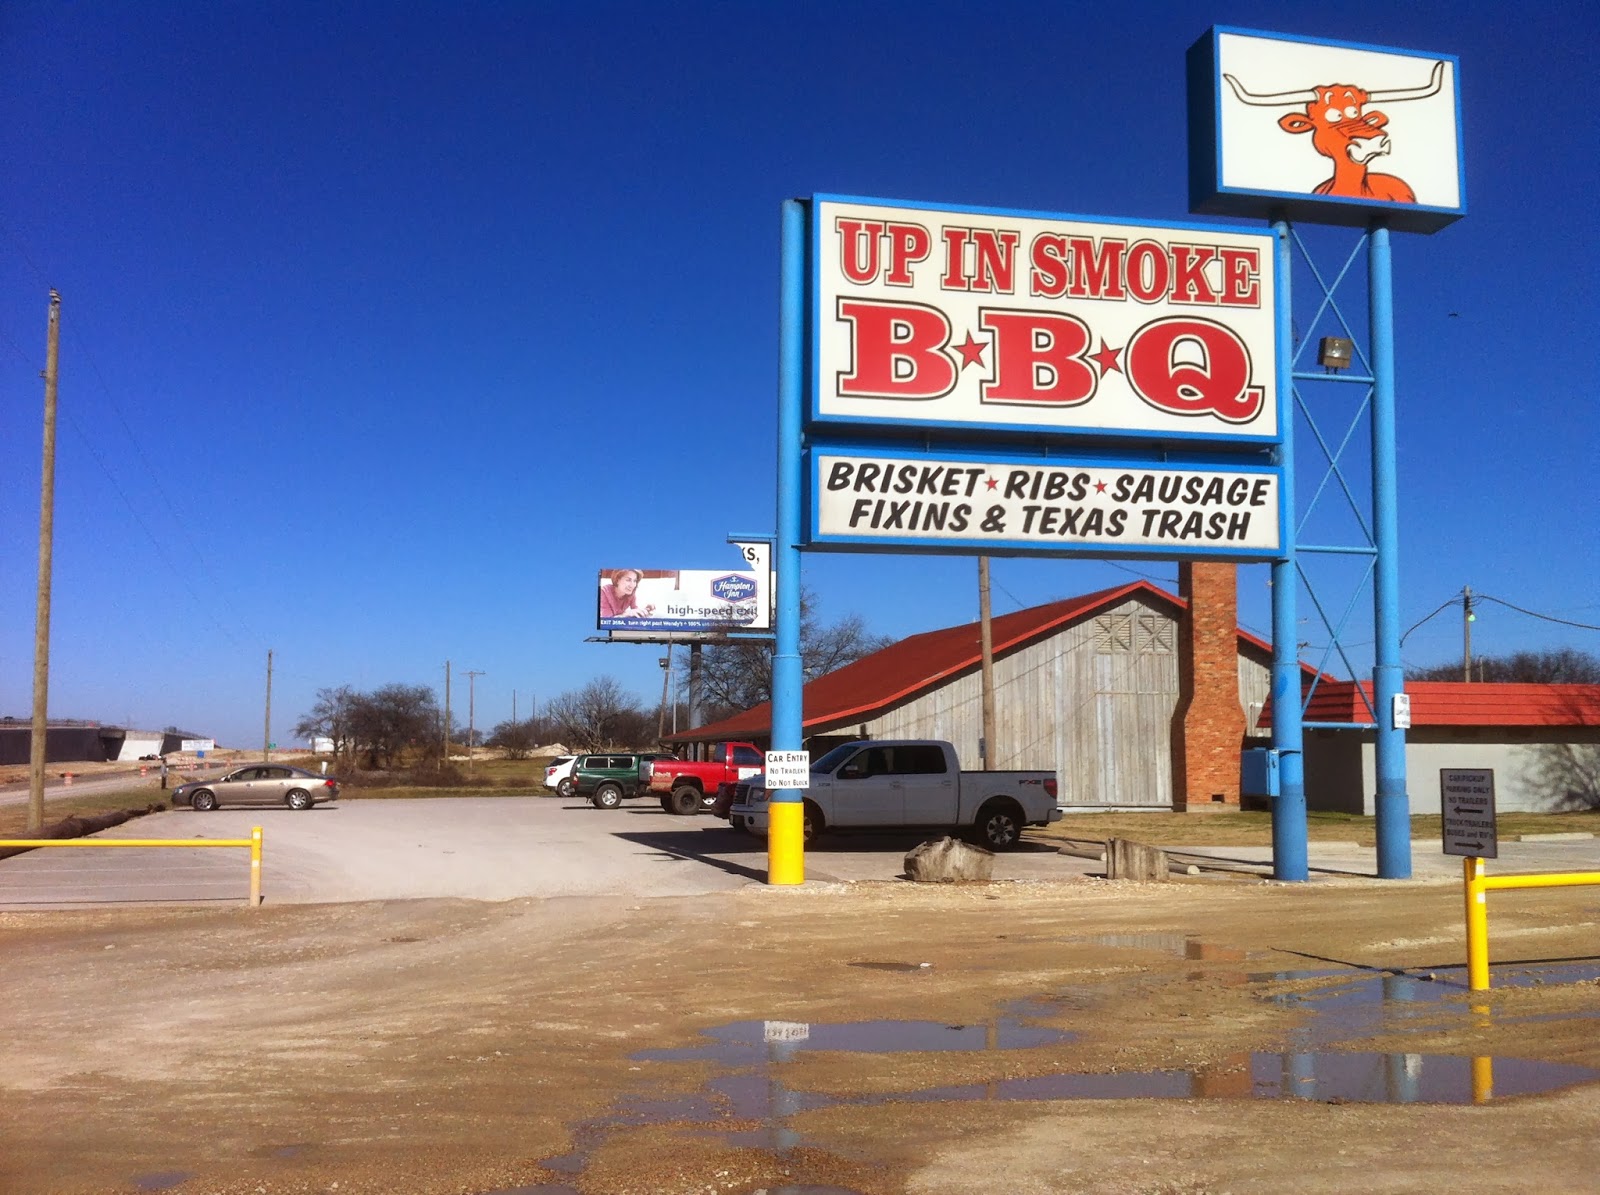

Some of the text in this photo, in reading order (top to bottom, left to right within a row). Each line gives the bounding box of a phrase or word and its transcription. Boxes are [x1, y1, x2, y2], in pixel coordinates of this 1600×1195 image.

[836, 217, 1261, 308] UP IN SMOKE
[827, 463, 1271, 507] BRISKET RIBS SAUSAGE
[849, 499, 1251, 540] FIXINS & TEXAS TRASH
[714, 580, 754, 593] Hampton
[723, 590, 744, 599] Inn
[667, 604, 733, 617] high-speed
